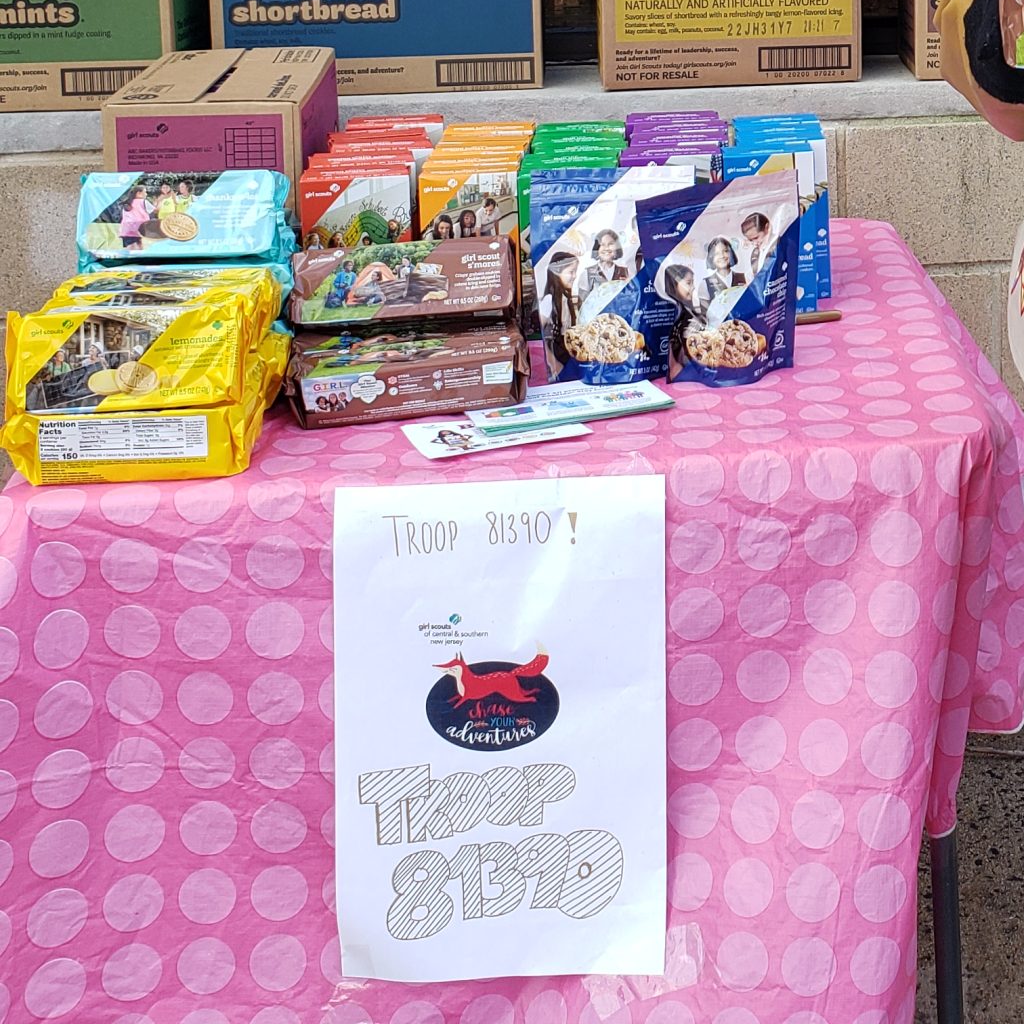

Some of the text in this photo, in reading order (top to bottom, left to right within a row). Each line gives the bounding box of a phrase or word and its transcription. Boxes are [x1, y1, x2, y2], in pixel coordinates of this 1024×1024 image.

[625, 0, 684, 11] NATURALLY
[686, 0, 709, 9] AND
[616, 70, 700, 81] NOT FOR RESALE
[62, 452, 78, 460] 150
[418, 622, 430, 631] girl
[444, 638, 464, 646] jersey
[490, 717, 516, 727] YOUR
[446, 720, 537, 745] adventures
[387, 829, 625, 941] 81390
